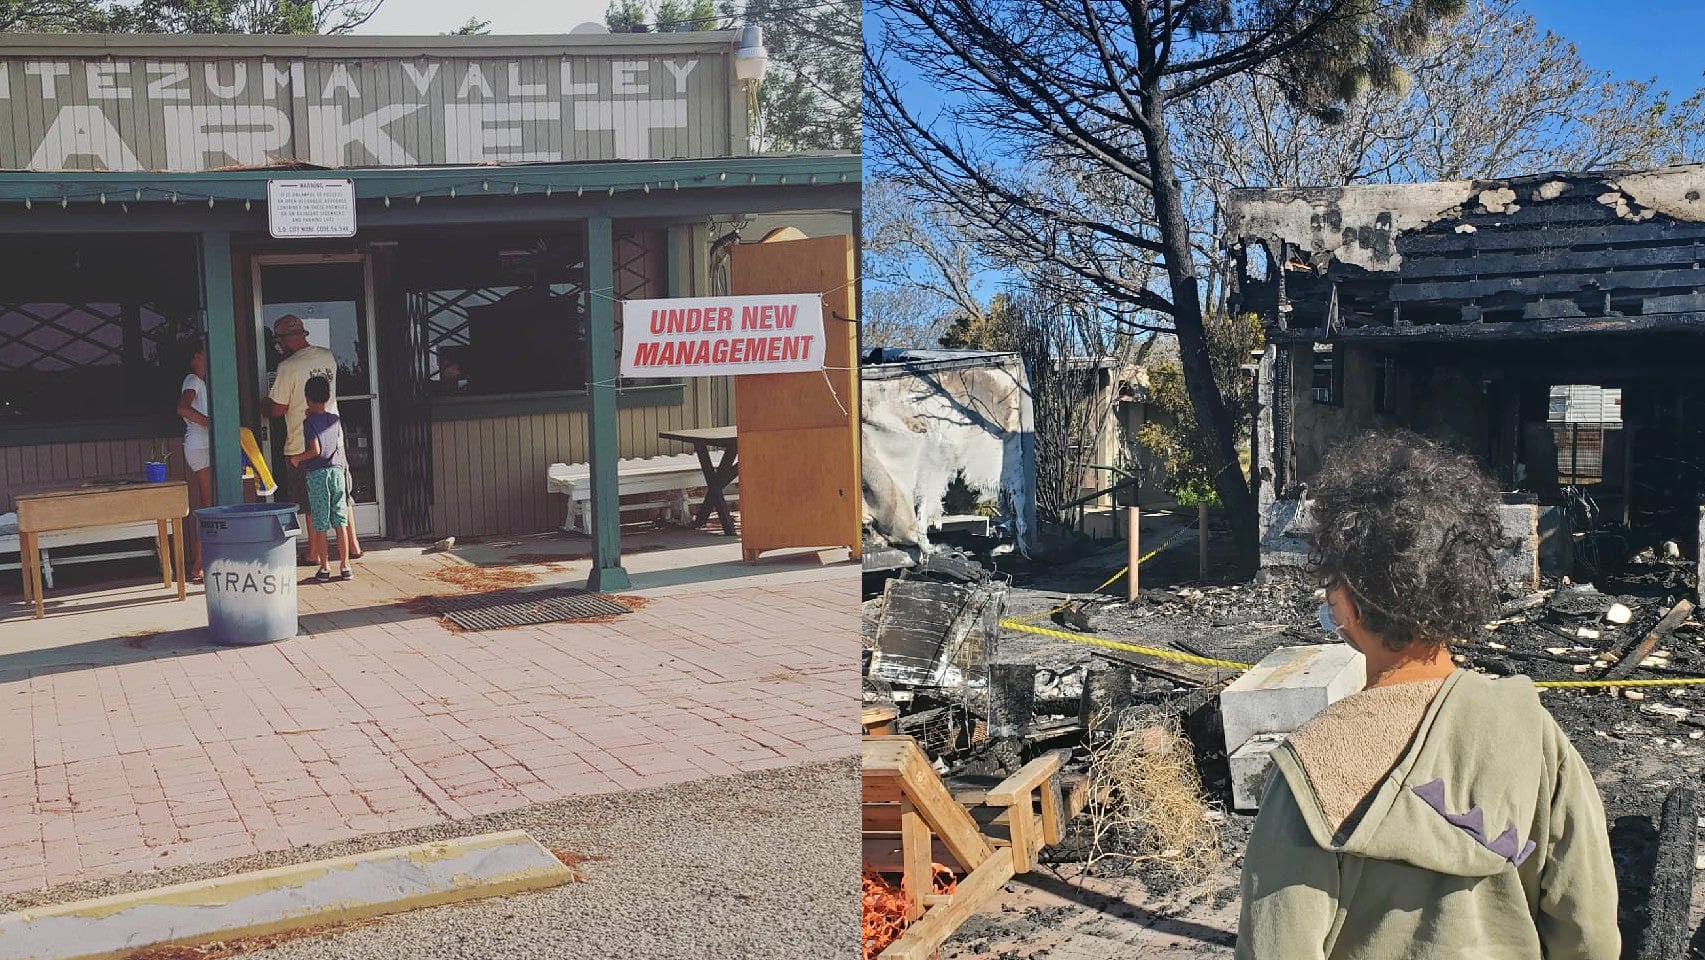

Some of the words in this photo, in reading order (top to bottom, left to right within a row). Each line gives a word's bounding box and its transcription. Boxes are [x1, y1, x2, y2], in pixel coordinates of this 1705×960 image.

[0, 60, 361, 100] TEZUMA
[401, 60, 699, 98] VALLEY
[26, 99, 688, 171] ARKET
[650, 306, 733, 335] UNDER
[741, 304, 798, 331] NEW
[633, 335, 814, 368] MANAGEMENT
[211, 571, 291, 595] TRASH
